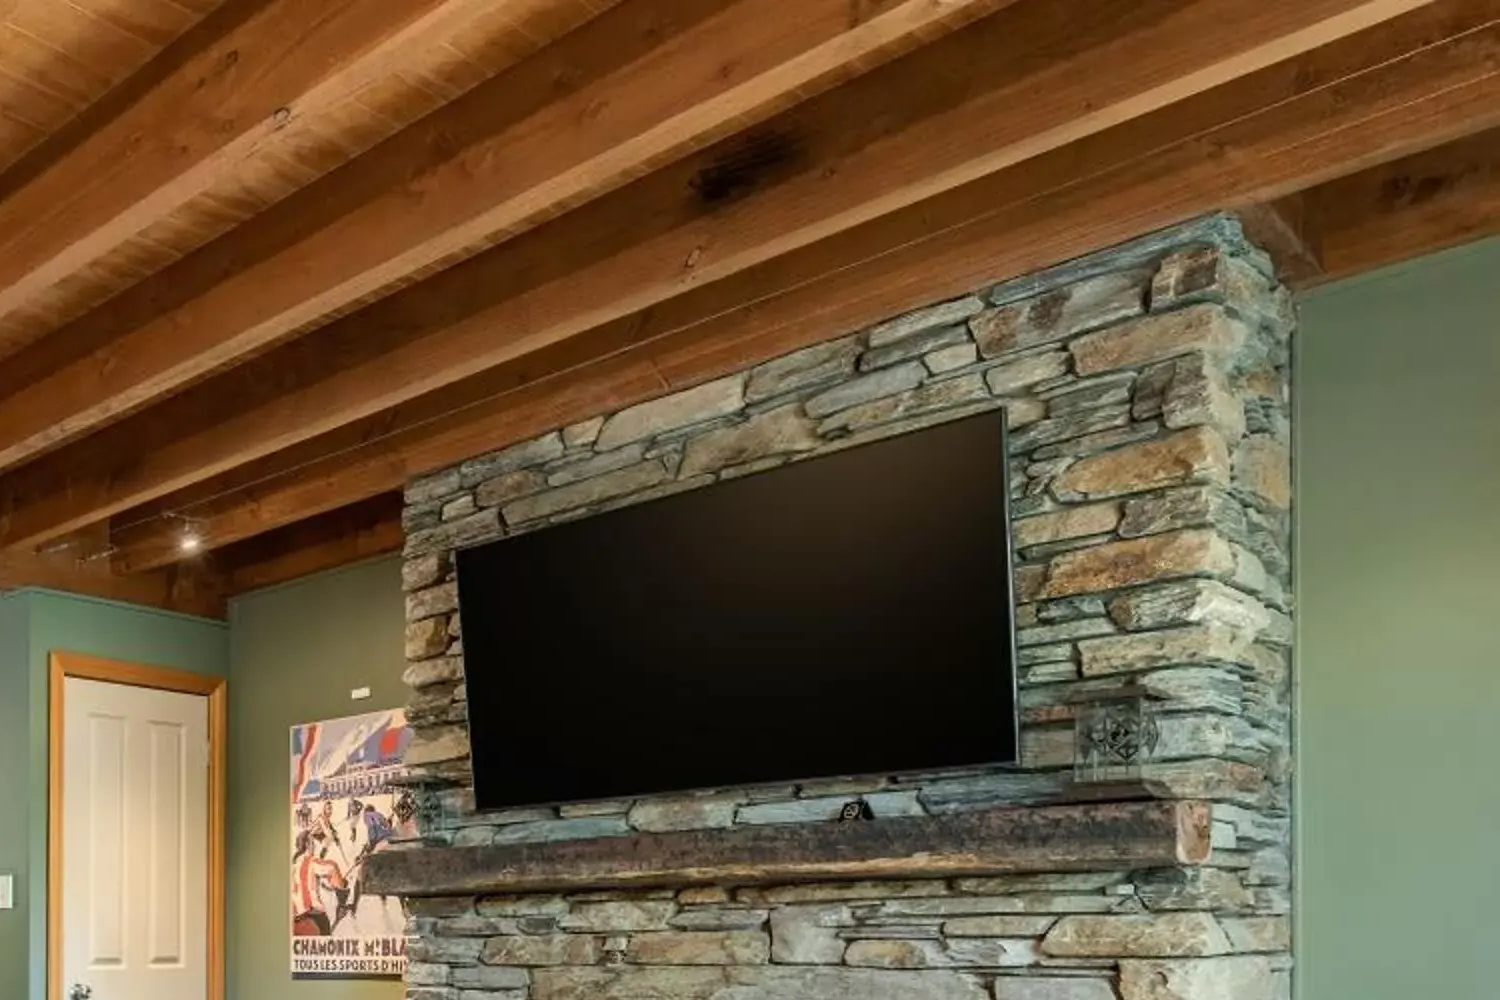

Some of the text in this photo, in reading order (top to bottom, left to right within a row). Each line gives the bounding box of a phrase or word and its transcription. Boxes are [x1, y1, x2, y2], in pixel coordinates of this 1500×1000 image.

[293, 939, 359, 956] CHAMONIX
[294, 959, 319, 971] TOUS
[320, 959, 338, 971] LES
[339, 959, 379, 971] SPORTS
